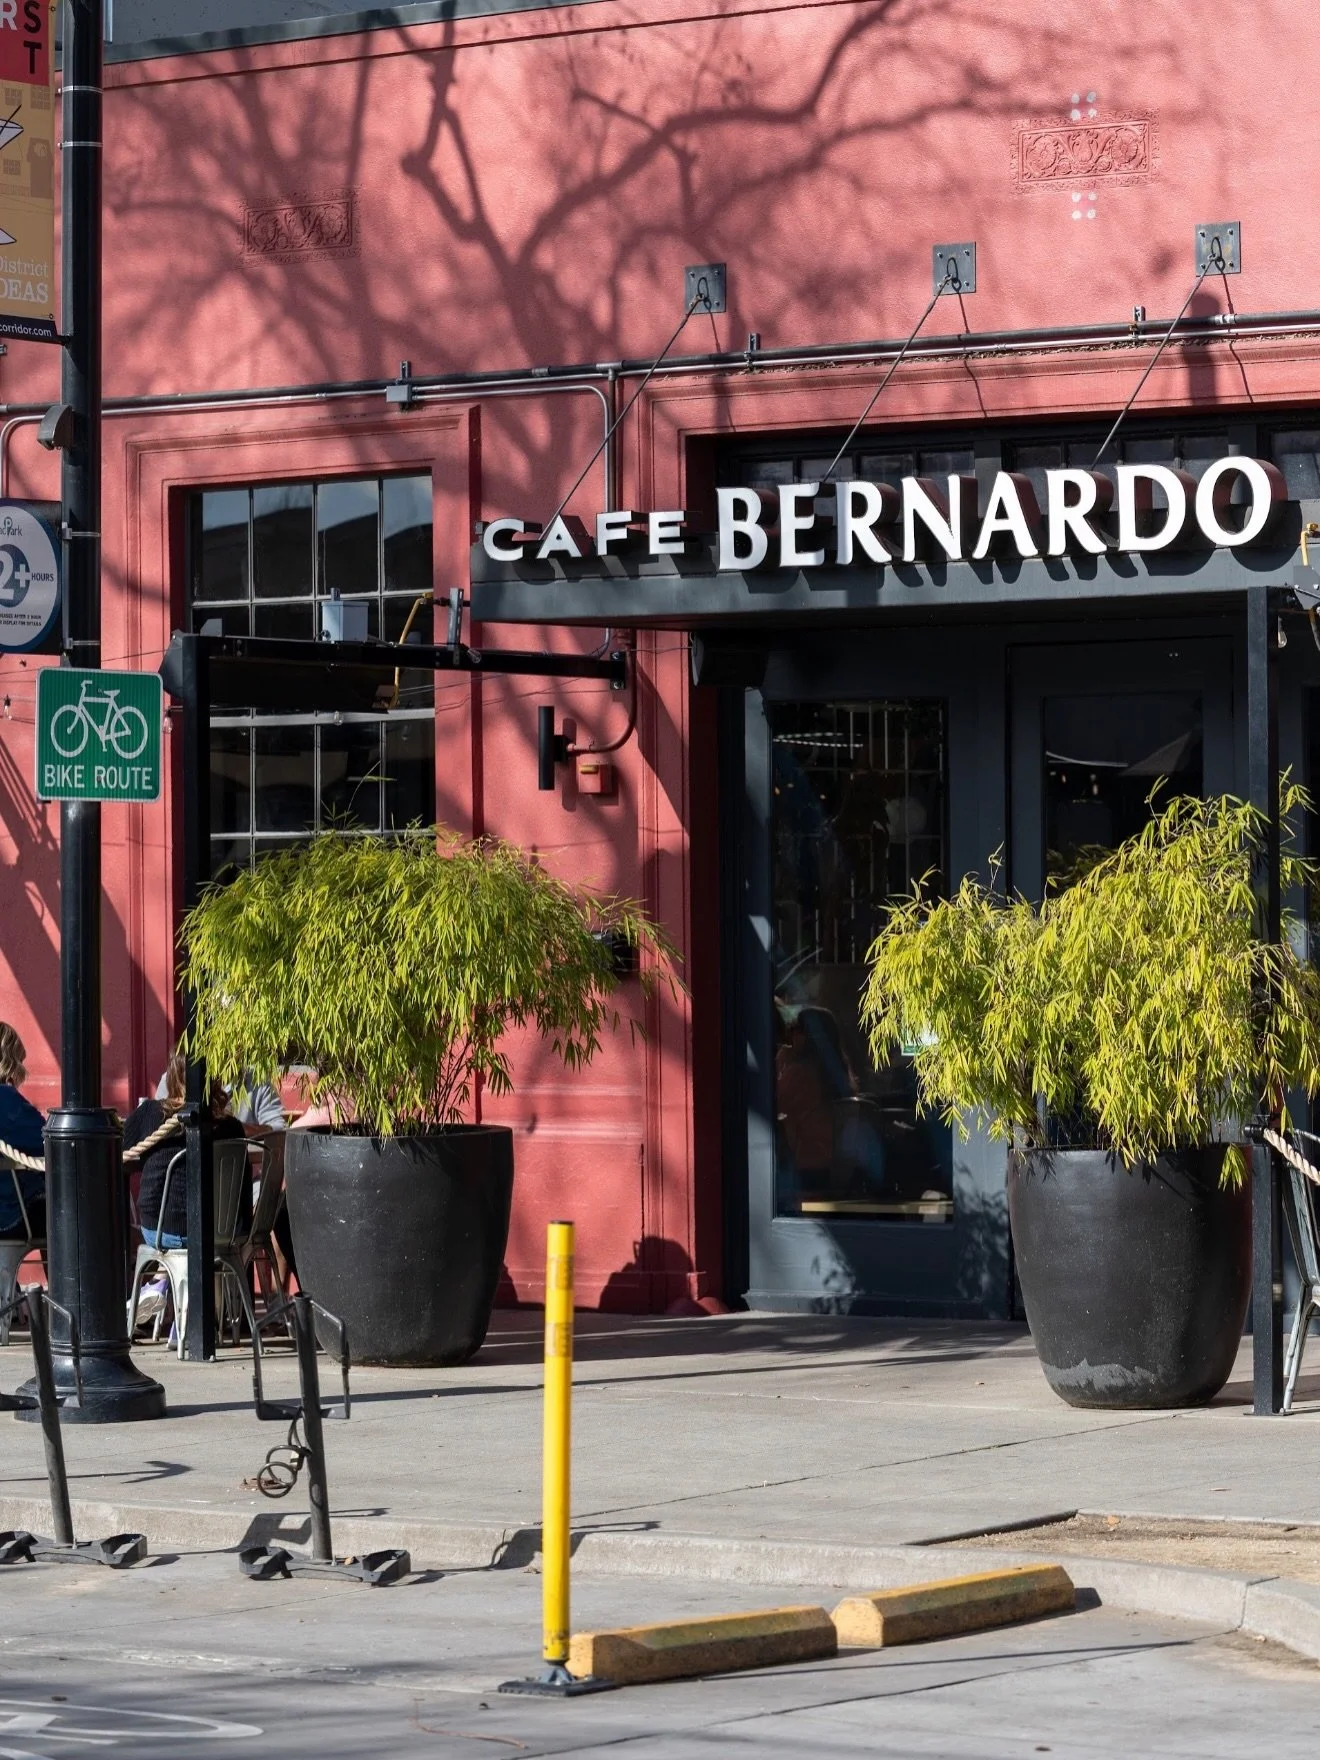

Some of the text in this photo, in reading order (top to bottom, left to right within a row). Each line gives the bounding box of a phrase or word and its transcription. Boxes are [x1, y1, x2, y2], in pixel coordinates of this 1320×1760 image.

[483, 456, 1272, 571] CAFE BERNARDO
[31, 572, 54, 582] HOURS
[44, 764, 153, 790] BIKE ROUTE
